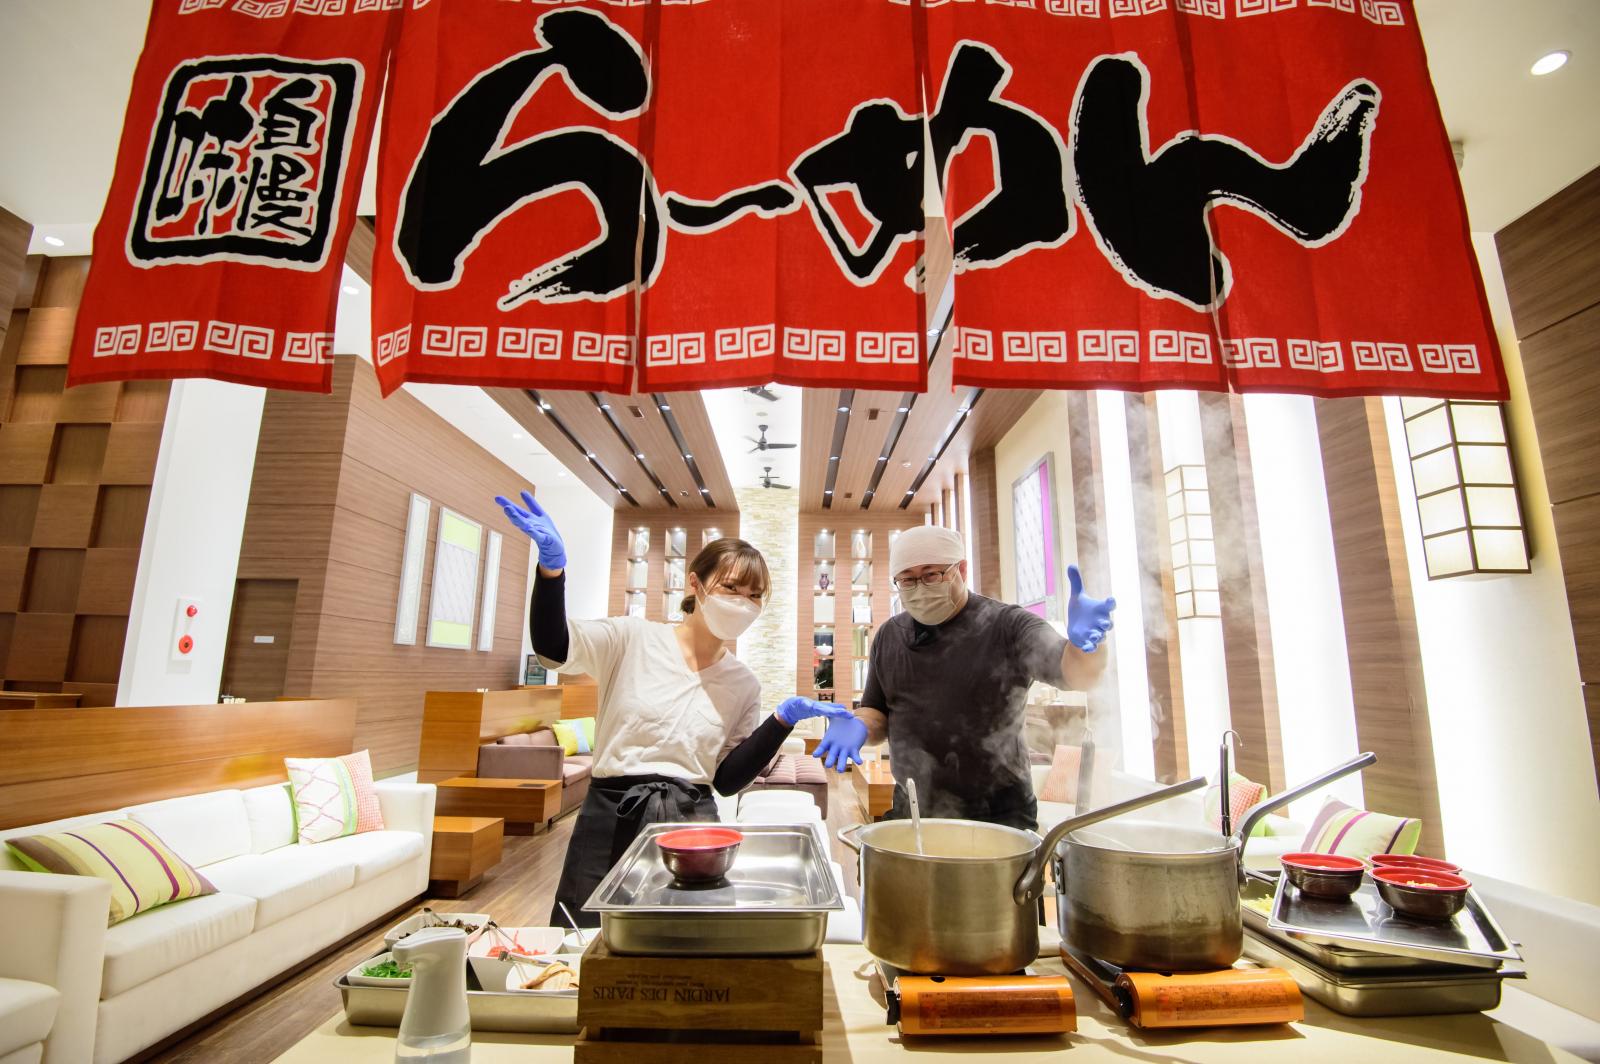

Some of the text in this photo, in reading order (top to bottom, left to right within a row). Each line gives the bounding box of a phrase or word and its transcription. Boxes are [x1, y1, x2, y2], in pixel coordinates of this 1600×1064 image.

[393, 7, 1381, 312] らーめん
[593, 986, 730, 1001] JARDIN DES PARIS
